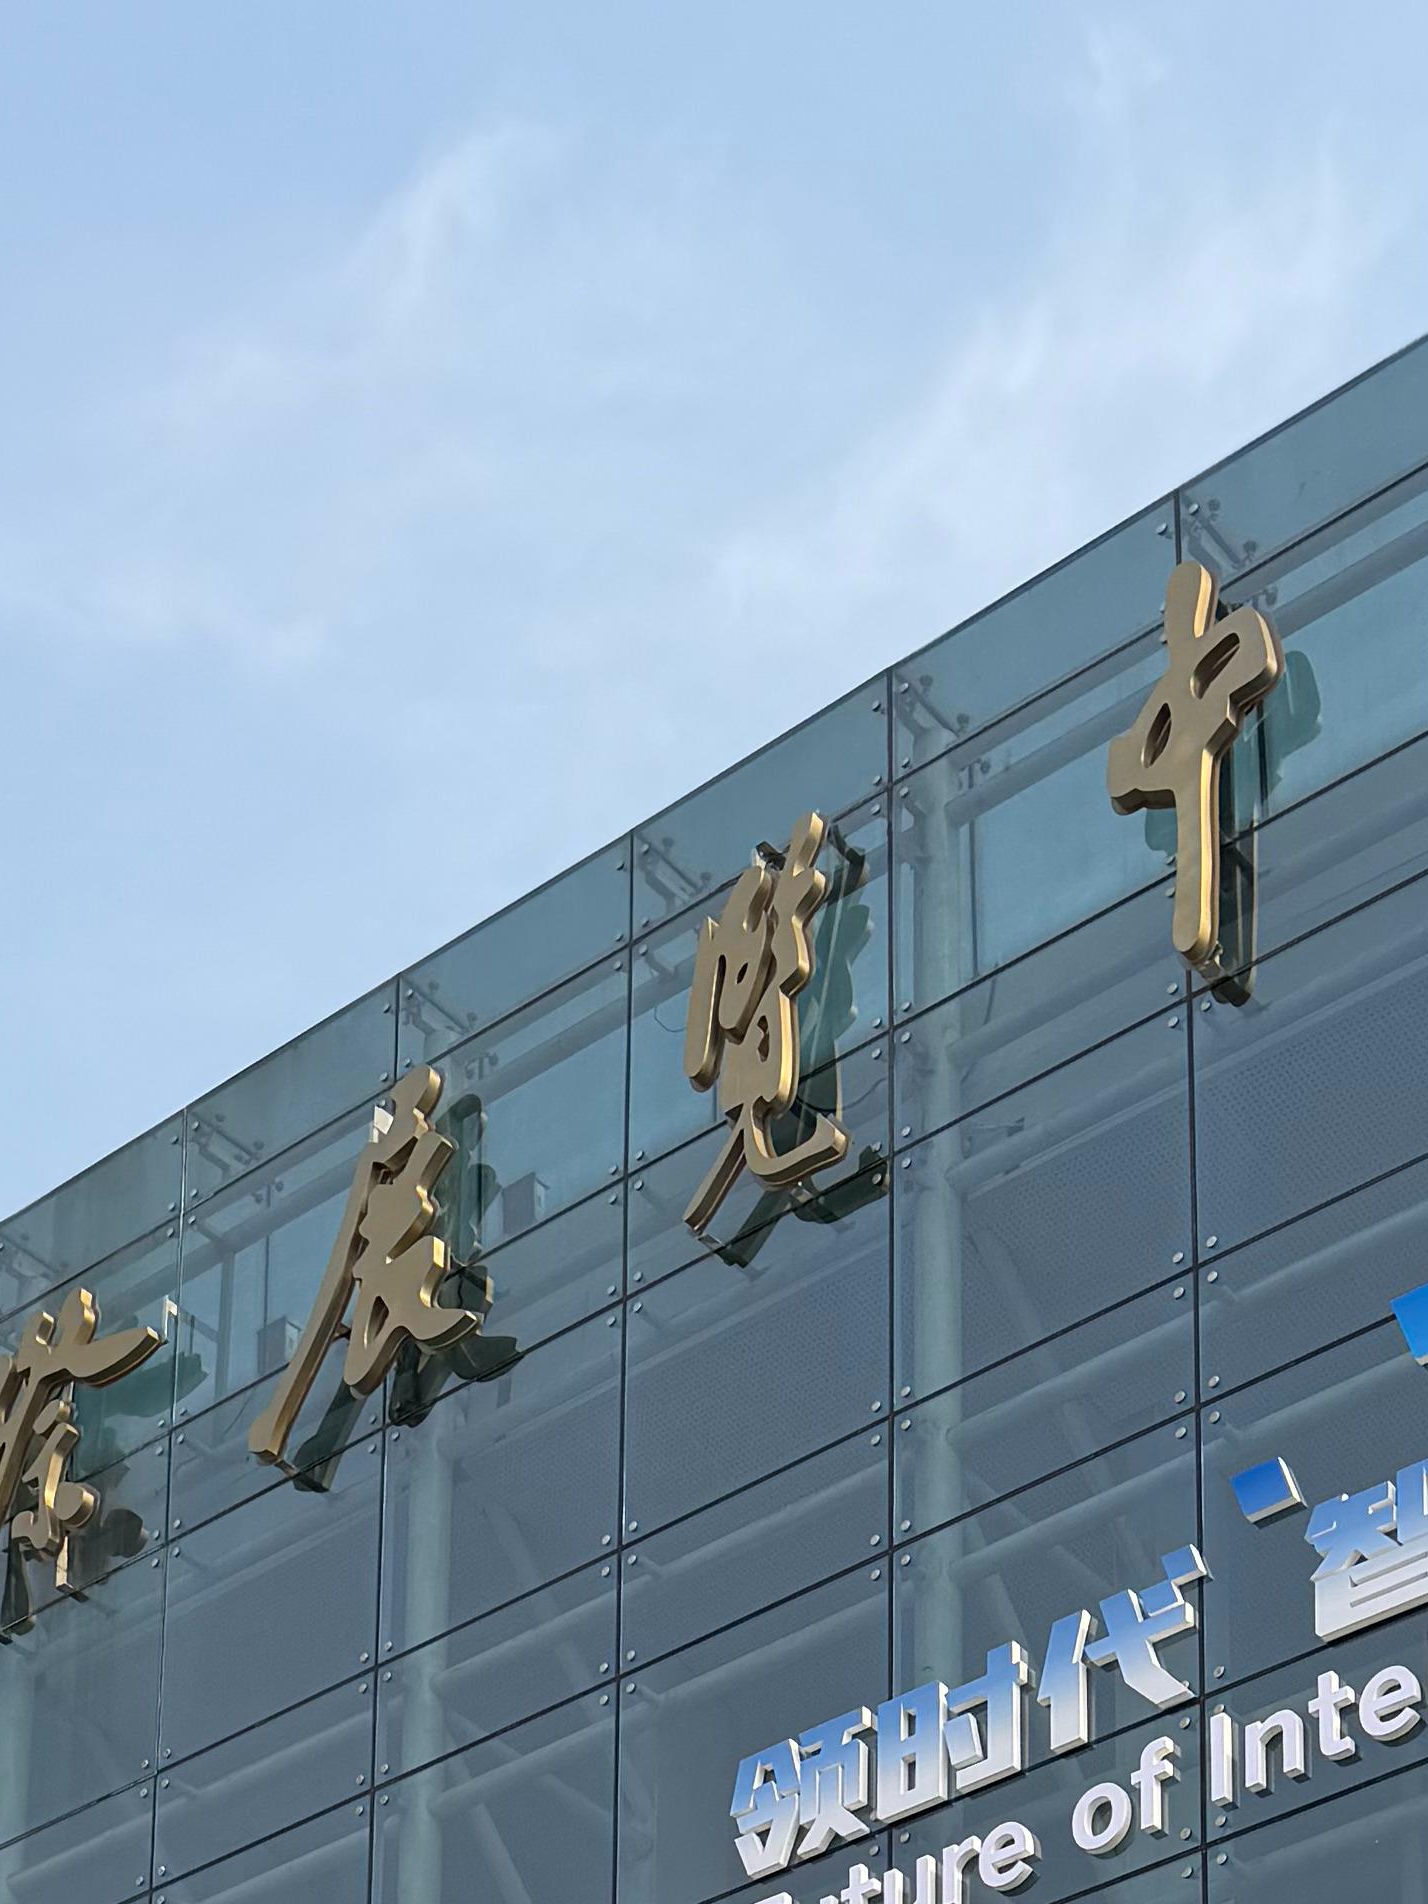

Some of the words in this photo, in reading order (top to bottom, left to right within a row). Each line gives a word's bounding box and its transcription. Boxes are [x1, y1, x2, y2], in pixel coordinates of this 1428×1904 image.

[730, 1543, 1212, 1880] 领时代
[1071, 1735, 1182, 1854] of
